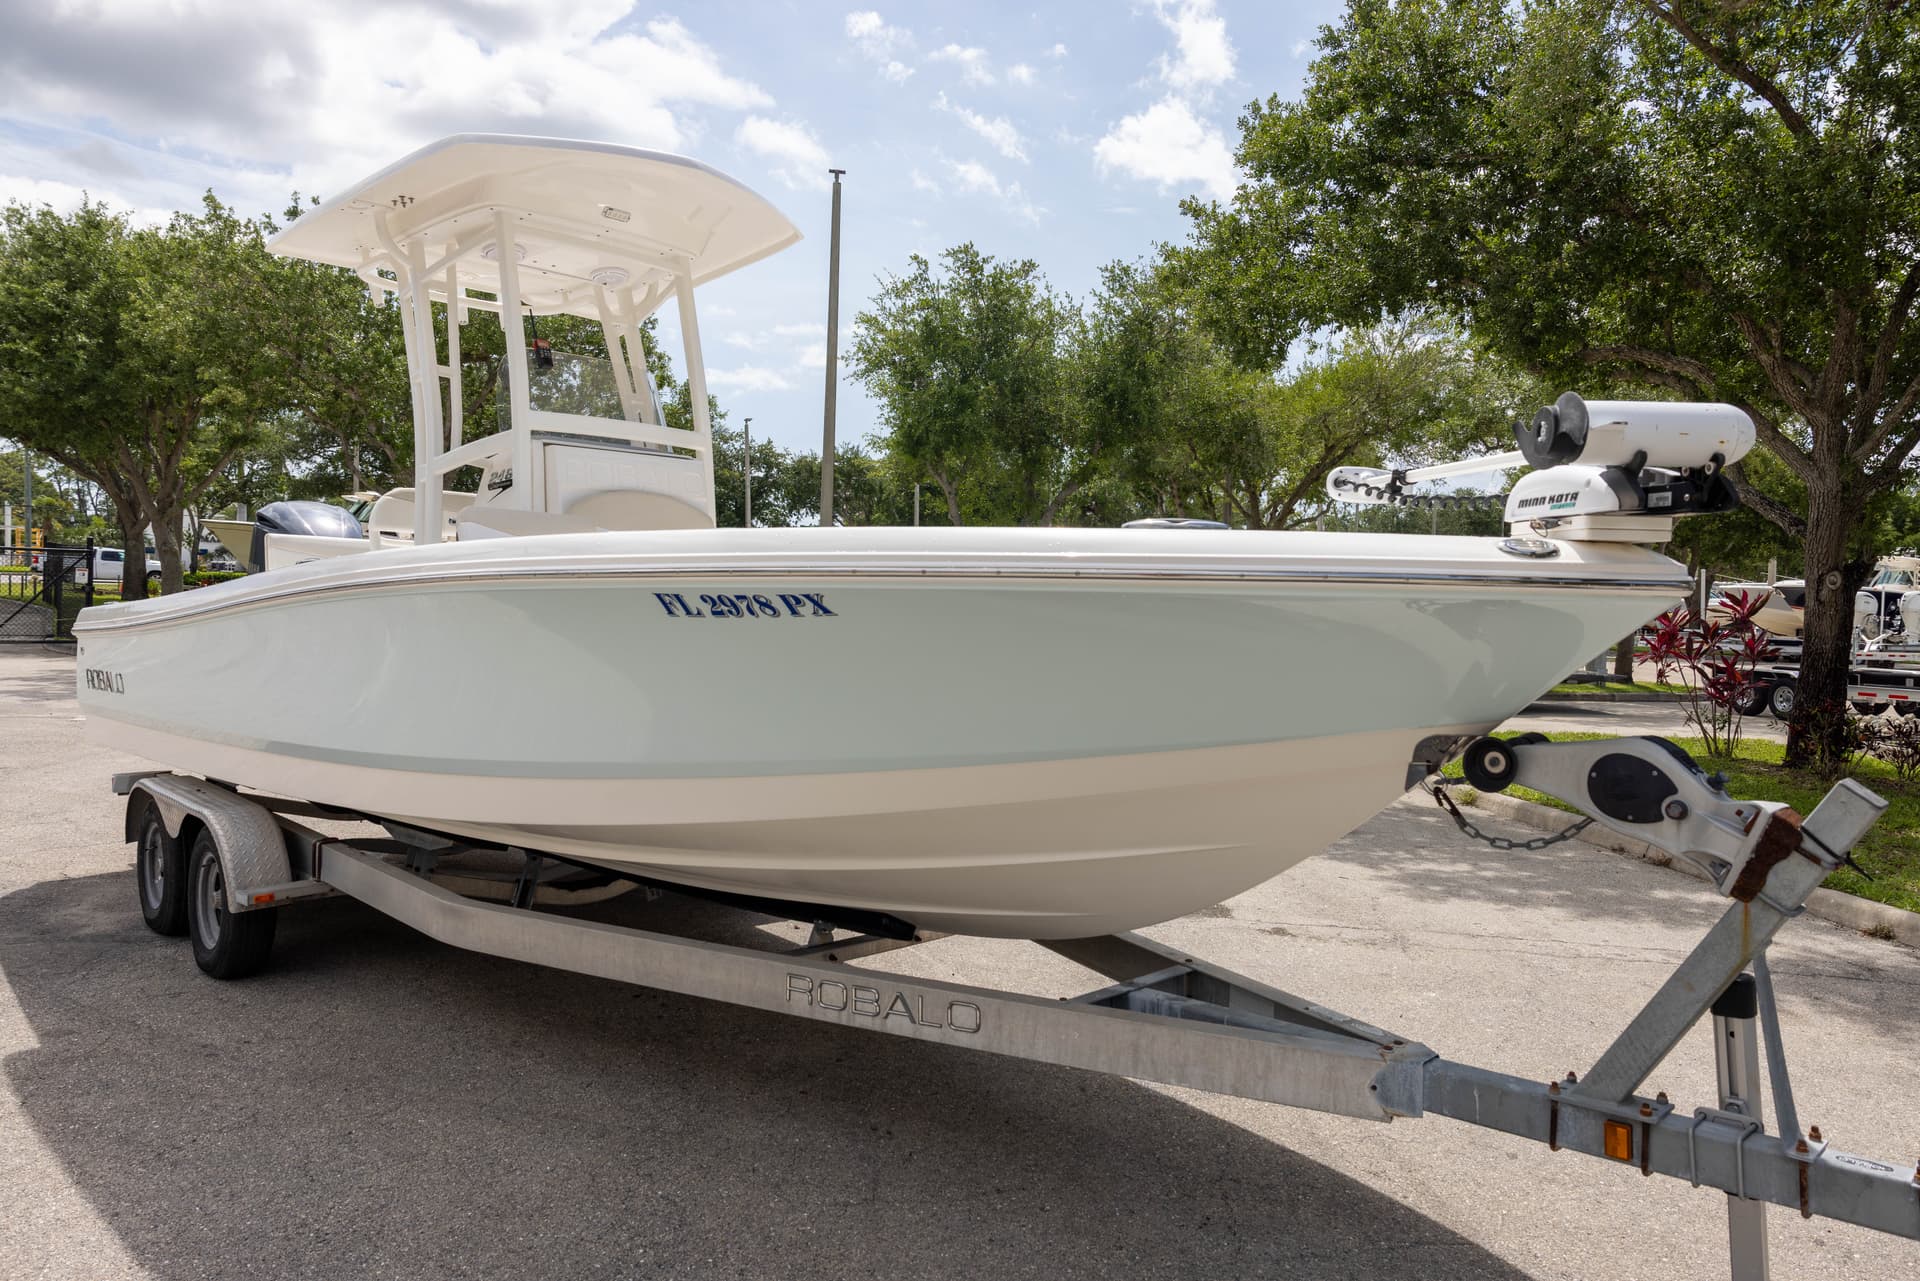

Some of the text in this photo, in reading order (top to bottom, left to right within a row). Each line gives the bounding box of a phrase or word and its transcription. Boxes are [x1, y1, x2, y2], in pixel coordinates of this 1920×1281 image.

[1518, 497, 1547, 508] MINN
[1548, 491, 1579, 504] KOTA
[652, 592, 839, 618] FL 2978 PX
[786, 973, 981, 1033] ROBALO
